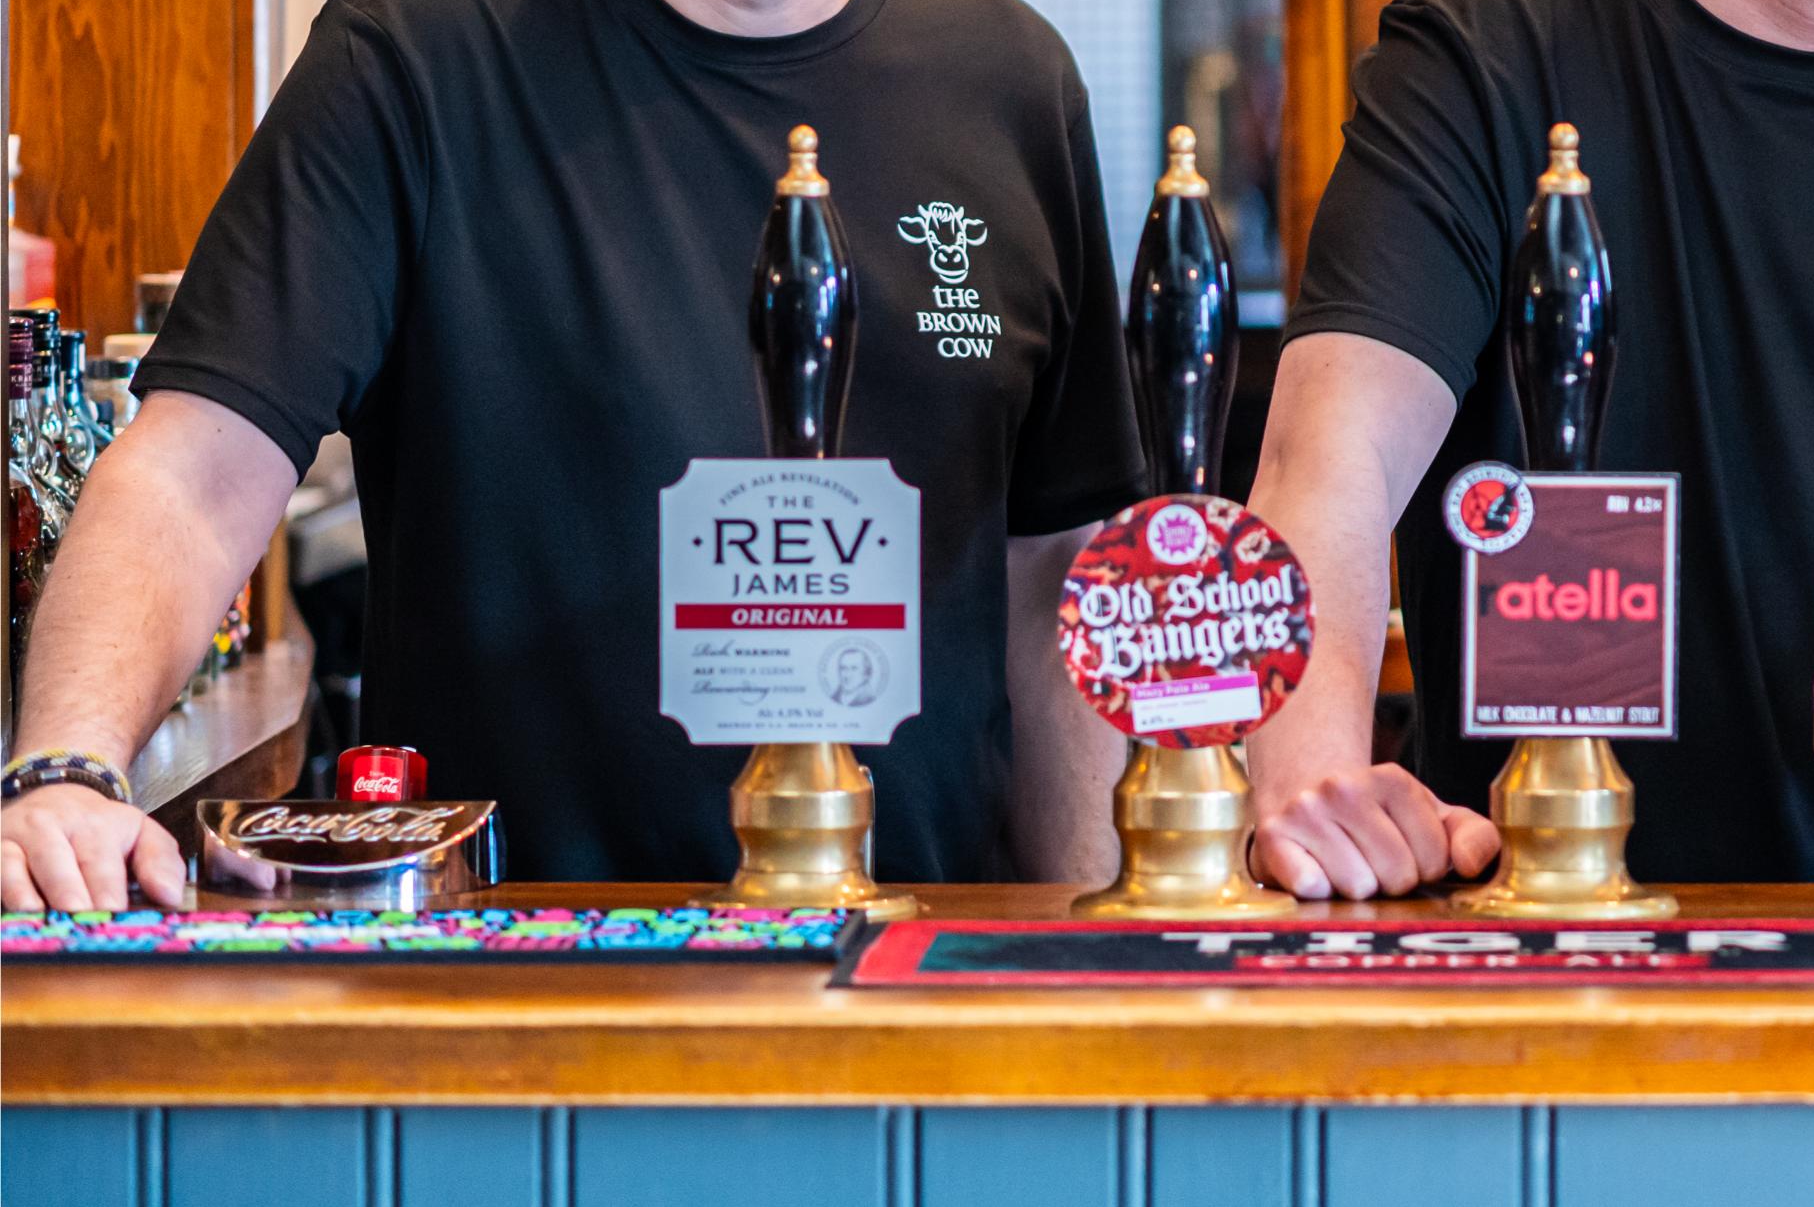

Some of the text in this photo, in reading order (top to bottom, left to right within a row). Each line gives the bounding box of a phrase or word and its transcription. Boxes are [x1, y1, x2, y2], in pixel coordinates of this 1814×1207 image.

[916, 311, 1001, 336] BROWN
[938, 337, 993, 359] COW
[767, 495, 815, 509] THE
[713, 518, 873, 566] REV
[732, 573, 850, 597] JAMES
[1079, 564, 1294, 627] Old School
[731, 608, 848, 626] ORIGINAL
[1089, 608, 1292, 679] Bangers
[1160, 931, 1790, 953] TIGER
